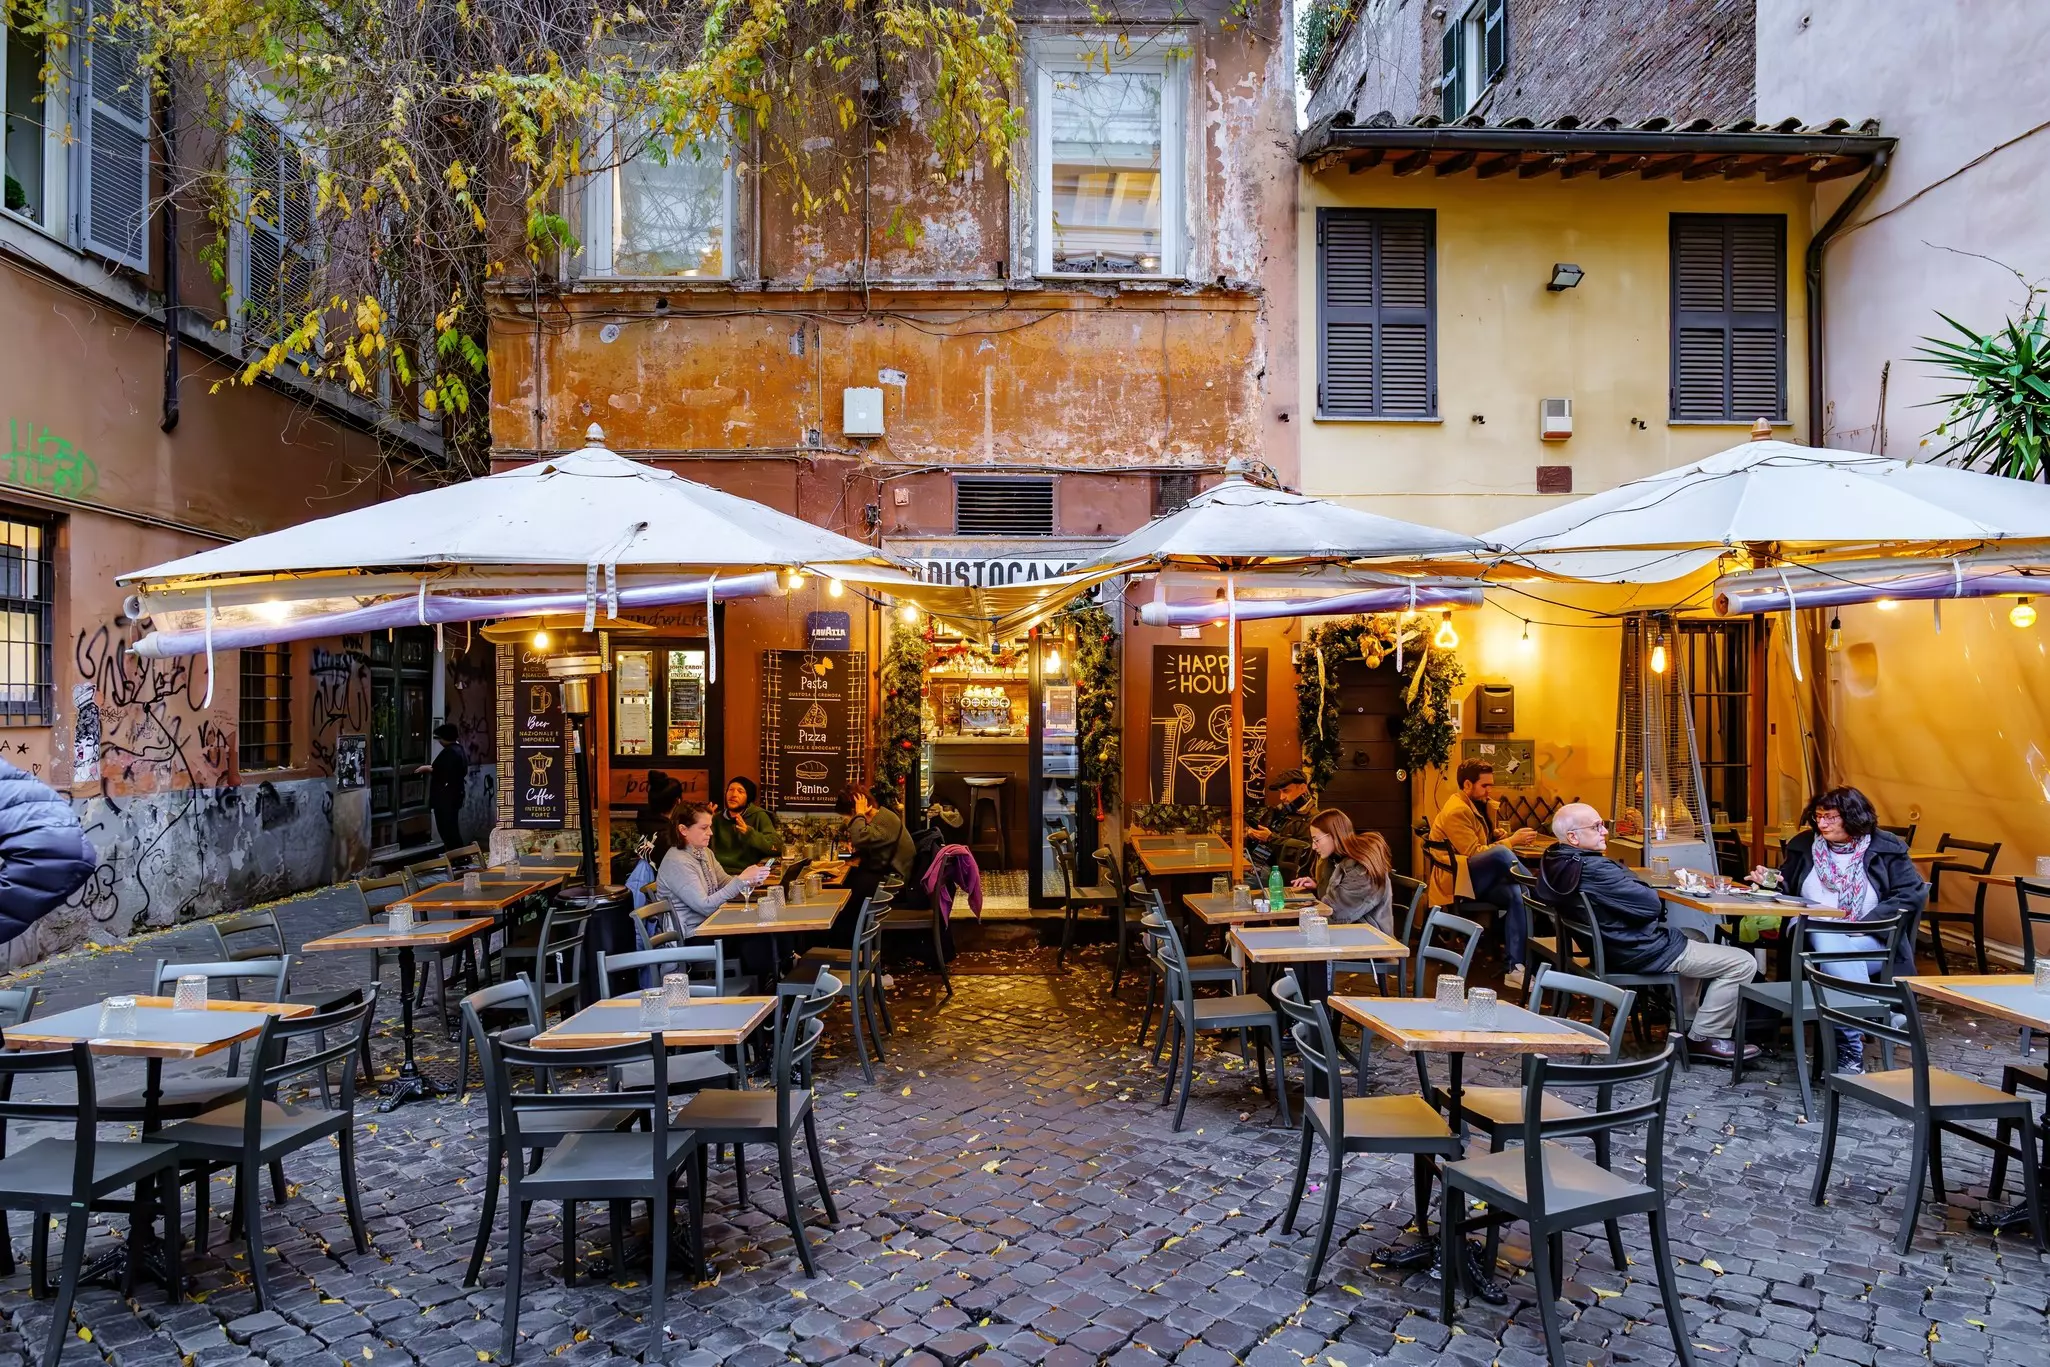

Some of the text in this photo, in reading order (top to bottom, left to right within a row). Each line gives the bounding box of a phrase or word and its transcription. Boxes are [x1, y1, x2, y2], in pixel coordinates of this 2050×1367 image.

[811, 626, 846, 637] LAVAZZA
[522, 650, 549, 664] Cockt
[1178, 654, 1230, 674] HAPP
[801, 676, 828, 690] Pasta
[1180, 674, 1232, 694] HOU
[527, 715, 550, 730] Beer
[799, 729, 827, 743] Pizza
[796, 781, 830, 795] Panino
[525, 787, 555, 806] Coffee
